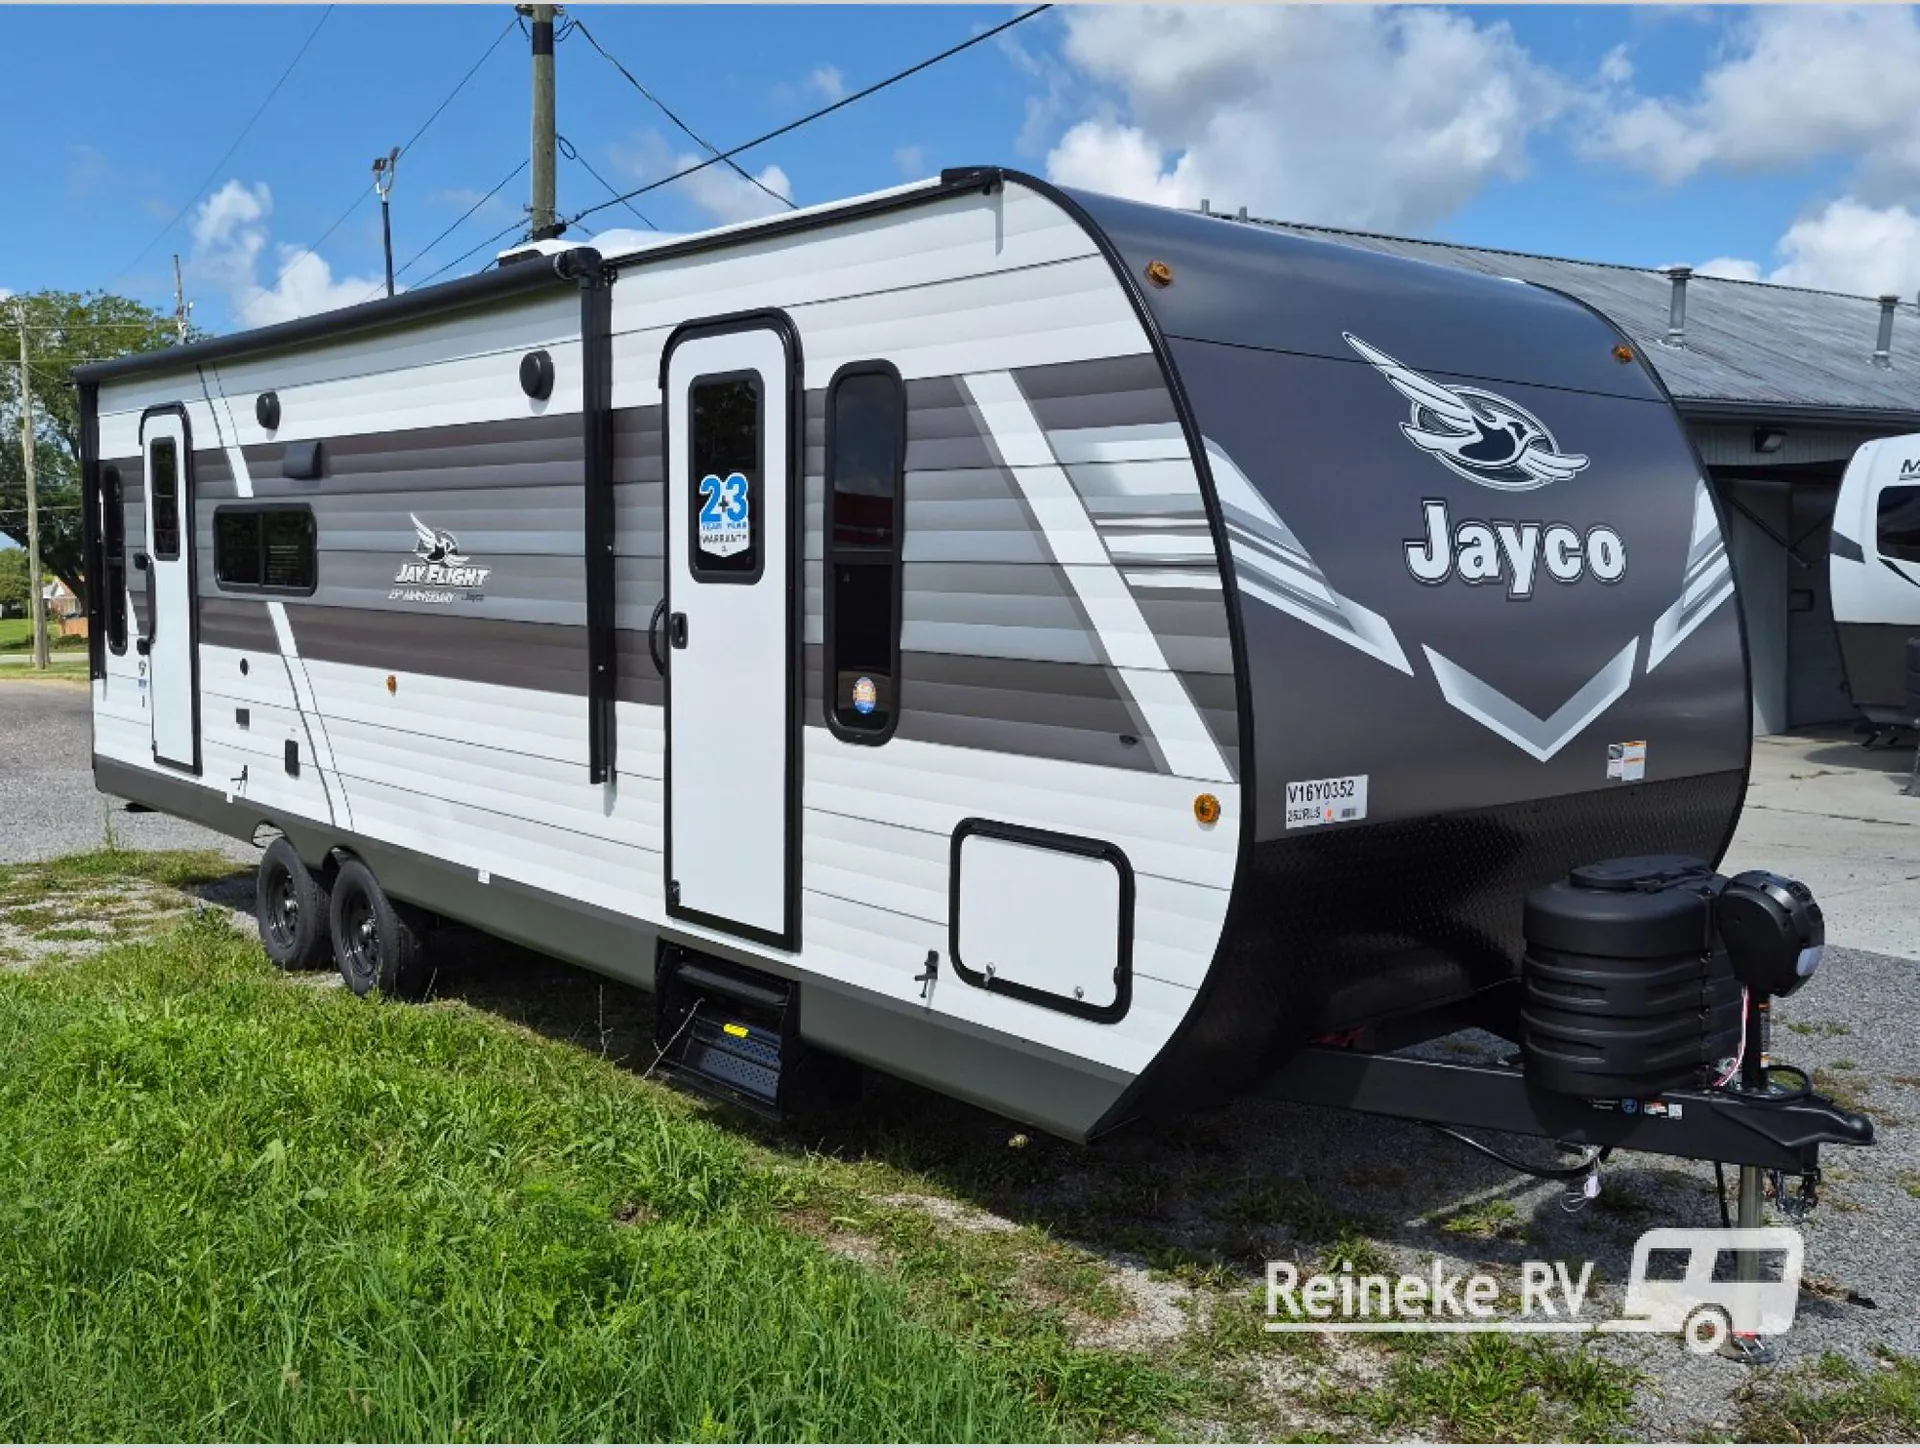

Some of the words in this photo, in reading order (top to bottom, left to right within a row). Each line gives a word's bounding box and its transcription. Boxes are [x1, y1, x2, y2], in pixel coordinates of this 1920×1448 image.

[1402, 498, 1627, 601] Jayco
[394, 563, 427, 584] JAY
[425, 563, 490, 588] FLIGHT
[1287, 780, 1354, 803] V16Y0352
